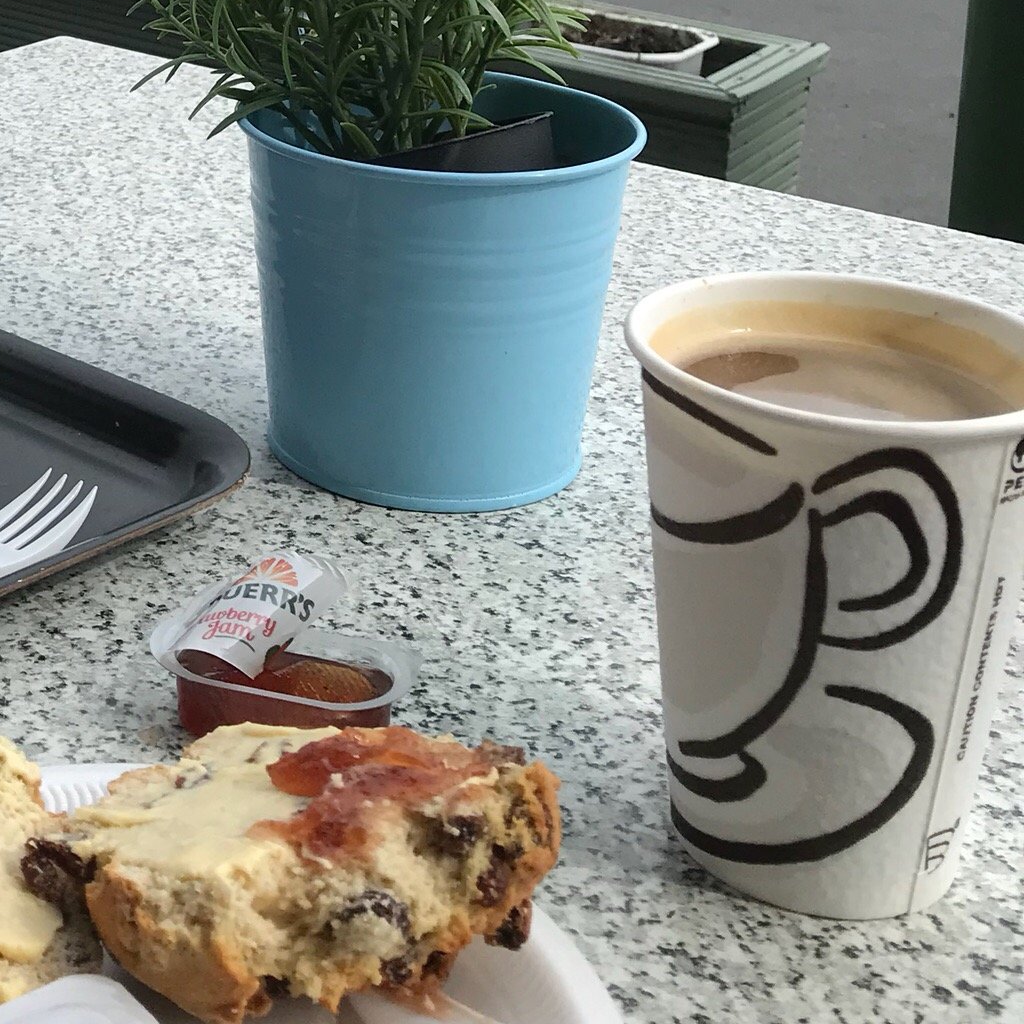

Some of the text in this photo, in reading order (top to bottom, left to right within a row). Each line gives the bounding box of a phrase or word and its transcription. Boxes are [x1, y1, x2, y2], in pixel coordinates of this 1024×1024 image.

[219, 582, 315, 623] UERR'S
[956, 576, 1006, 762] CAUTION CONTENTS HOT
